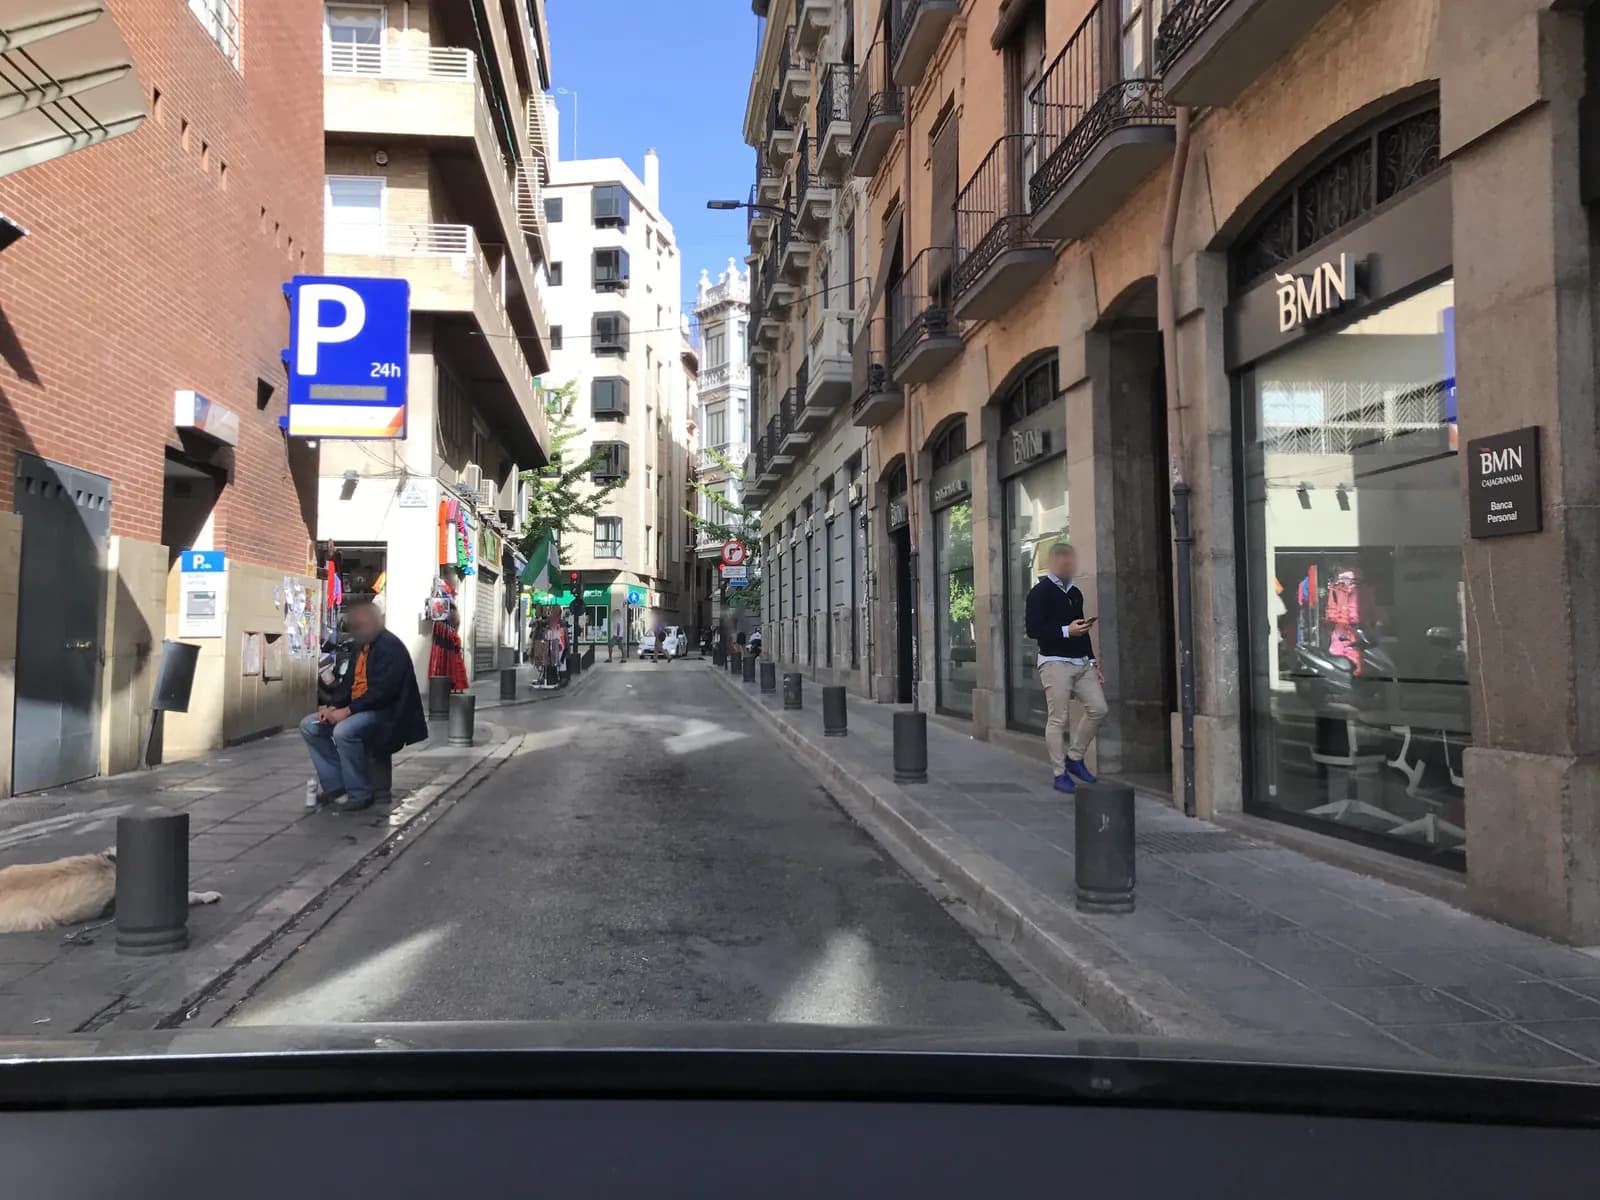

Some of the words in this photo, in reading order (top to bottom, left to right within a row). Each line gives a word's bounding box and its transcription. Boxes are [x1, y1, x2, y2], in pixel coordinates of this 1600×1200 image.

[1274, 252, 1352, 333] BMN
[296, 283, 366, 376] P
[370, 361, 401, 378] 24h
[1012, 430, 1043, 465] BMN
[1479, 444, 1523, 475] BMN
[1481, 473, 1523, 488] CAJAGRANADA
[1490, 500, 1513, 511] Banca
[1487, 511, 1518, 523] Personal
[192, 553, 205, 569] P
